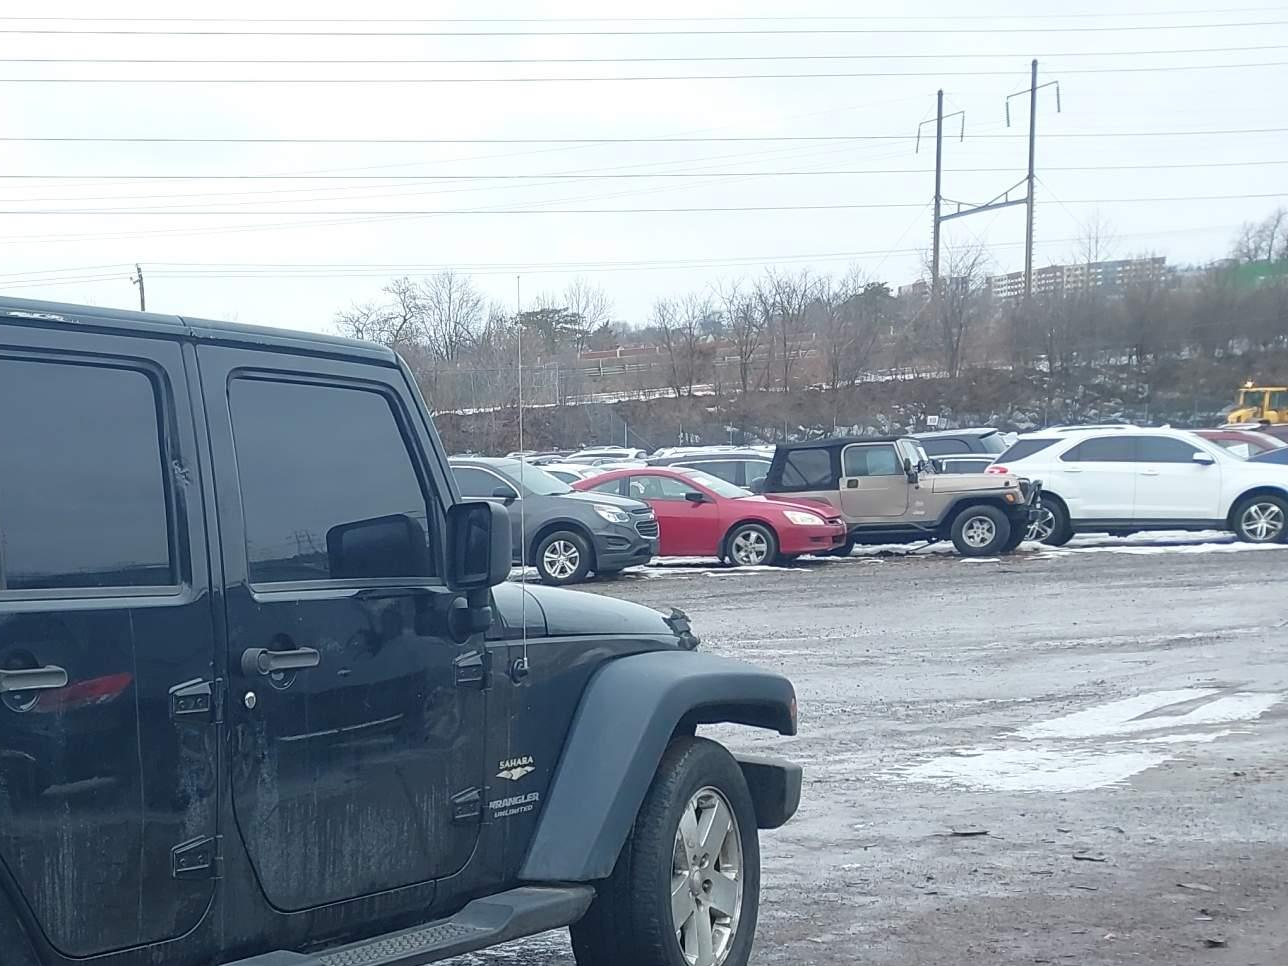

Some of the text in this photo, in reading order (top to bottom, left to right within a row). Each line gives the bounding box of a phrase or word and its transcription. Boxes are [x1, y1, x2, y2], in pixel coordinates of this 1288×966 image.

[499, 755, 534, 770] SAHARA
[489, 792, 540, 810] WRANGLER
[494, 804, 533, 818] UNLIMITED
